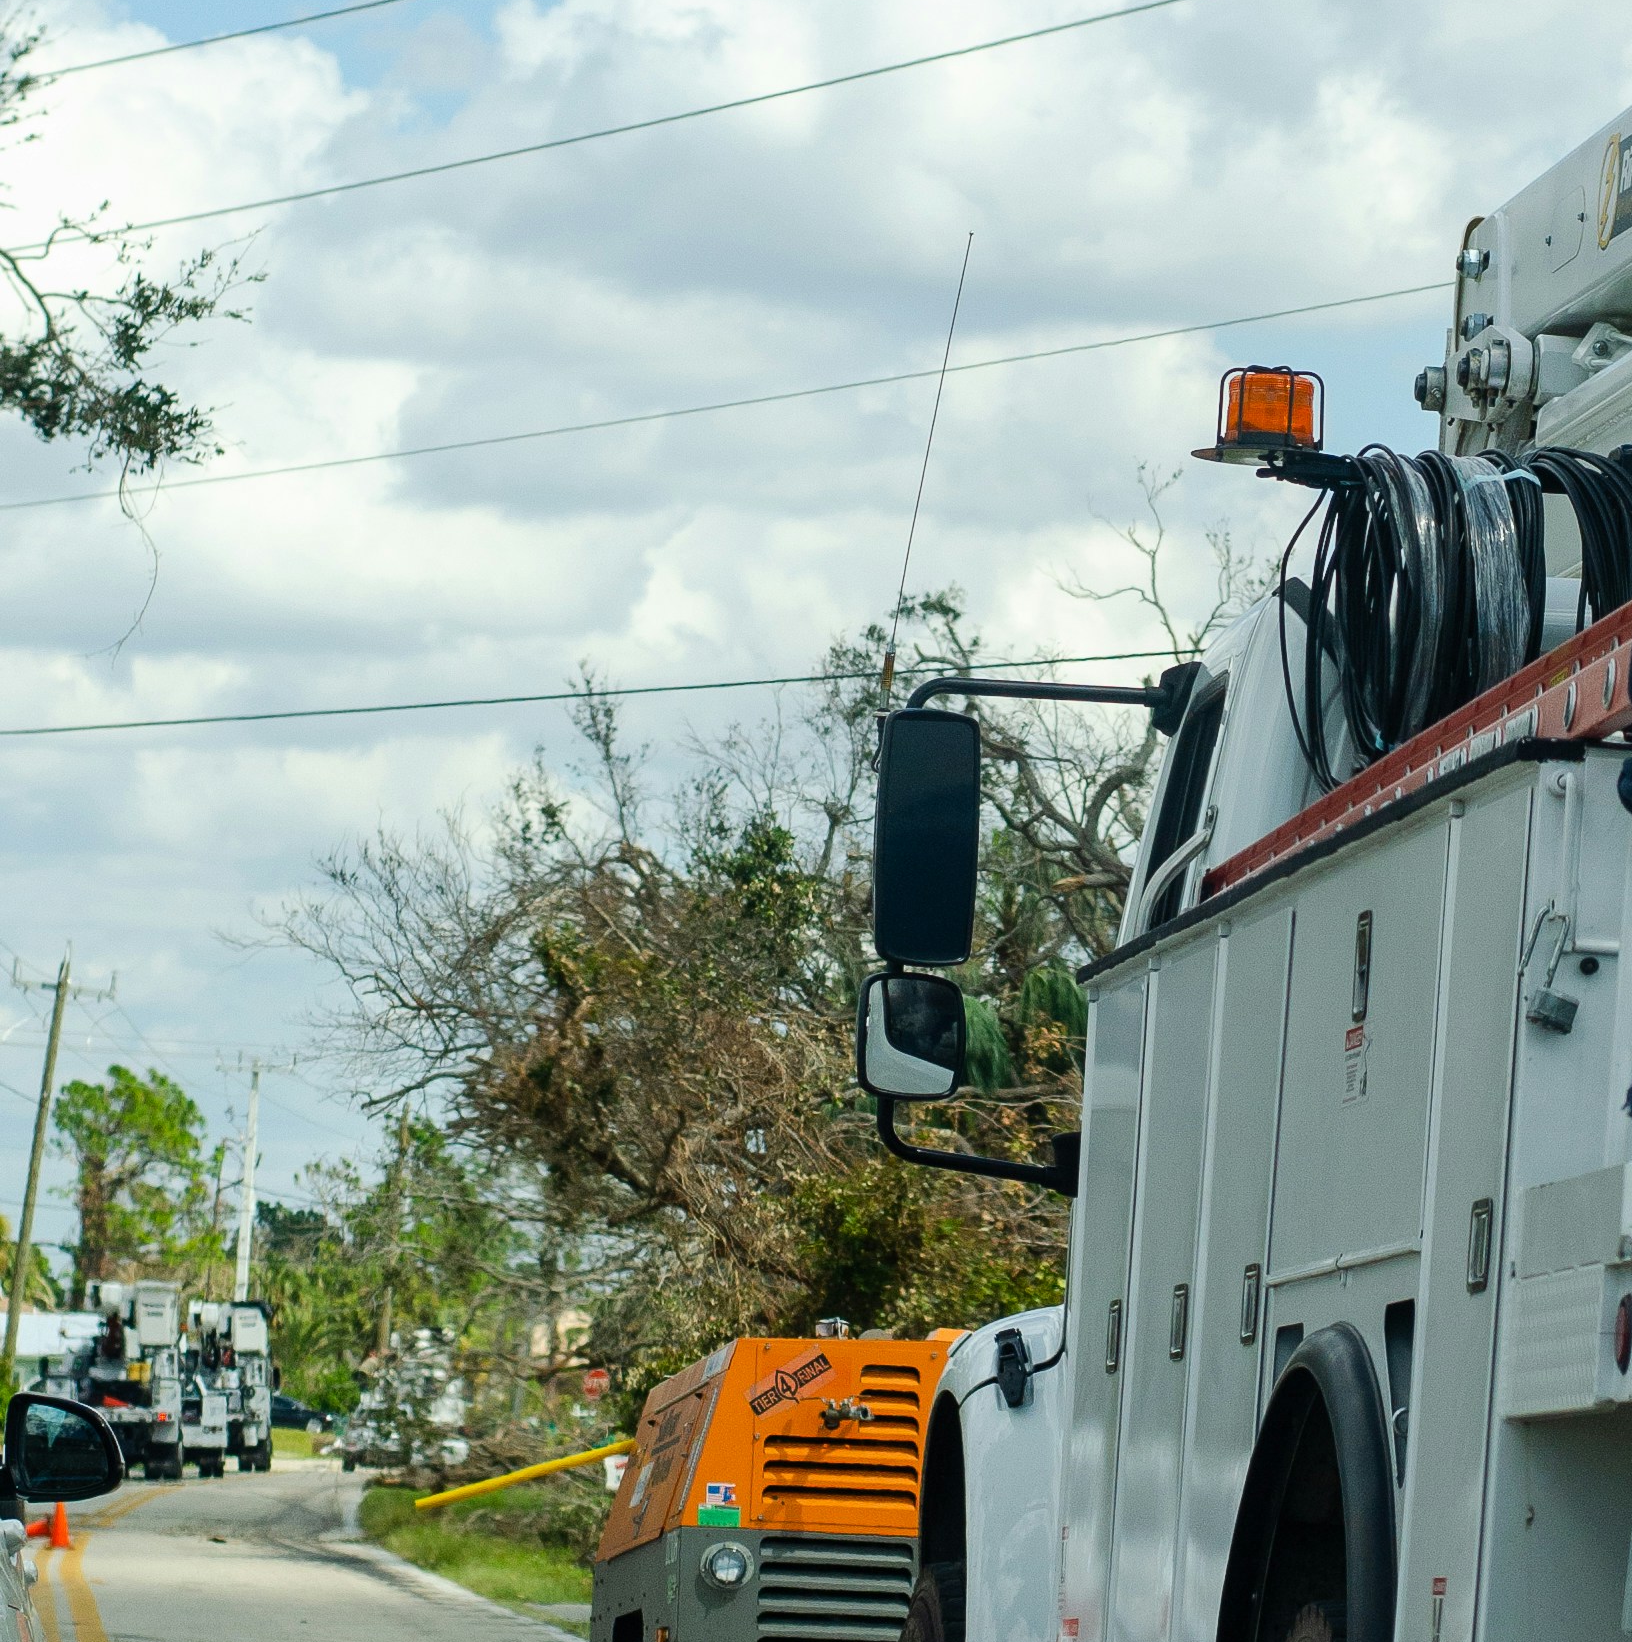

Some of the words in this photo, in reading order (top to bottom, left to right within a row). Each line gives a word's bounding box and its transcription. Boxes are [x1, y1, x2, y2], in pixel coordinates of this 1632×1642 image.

[751, 1390, 780, 1413] TIER
[779, 1375, 797, 1397] 4
[796, 1358, 830, 1382] FINAL
